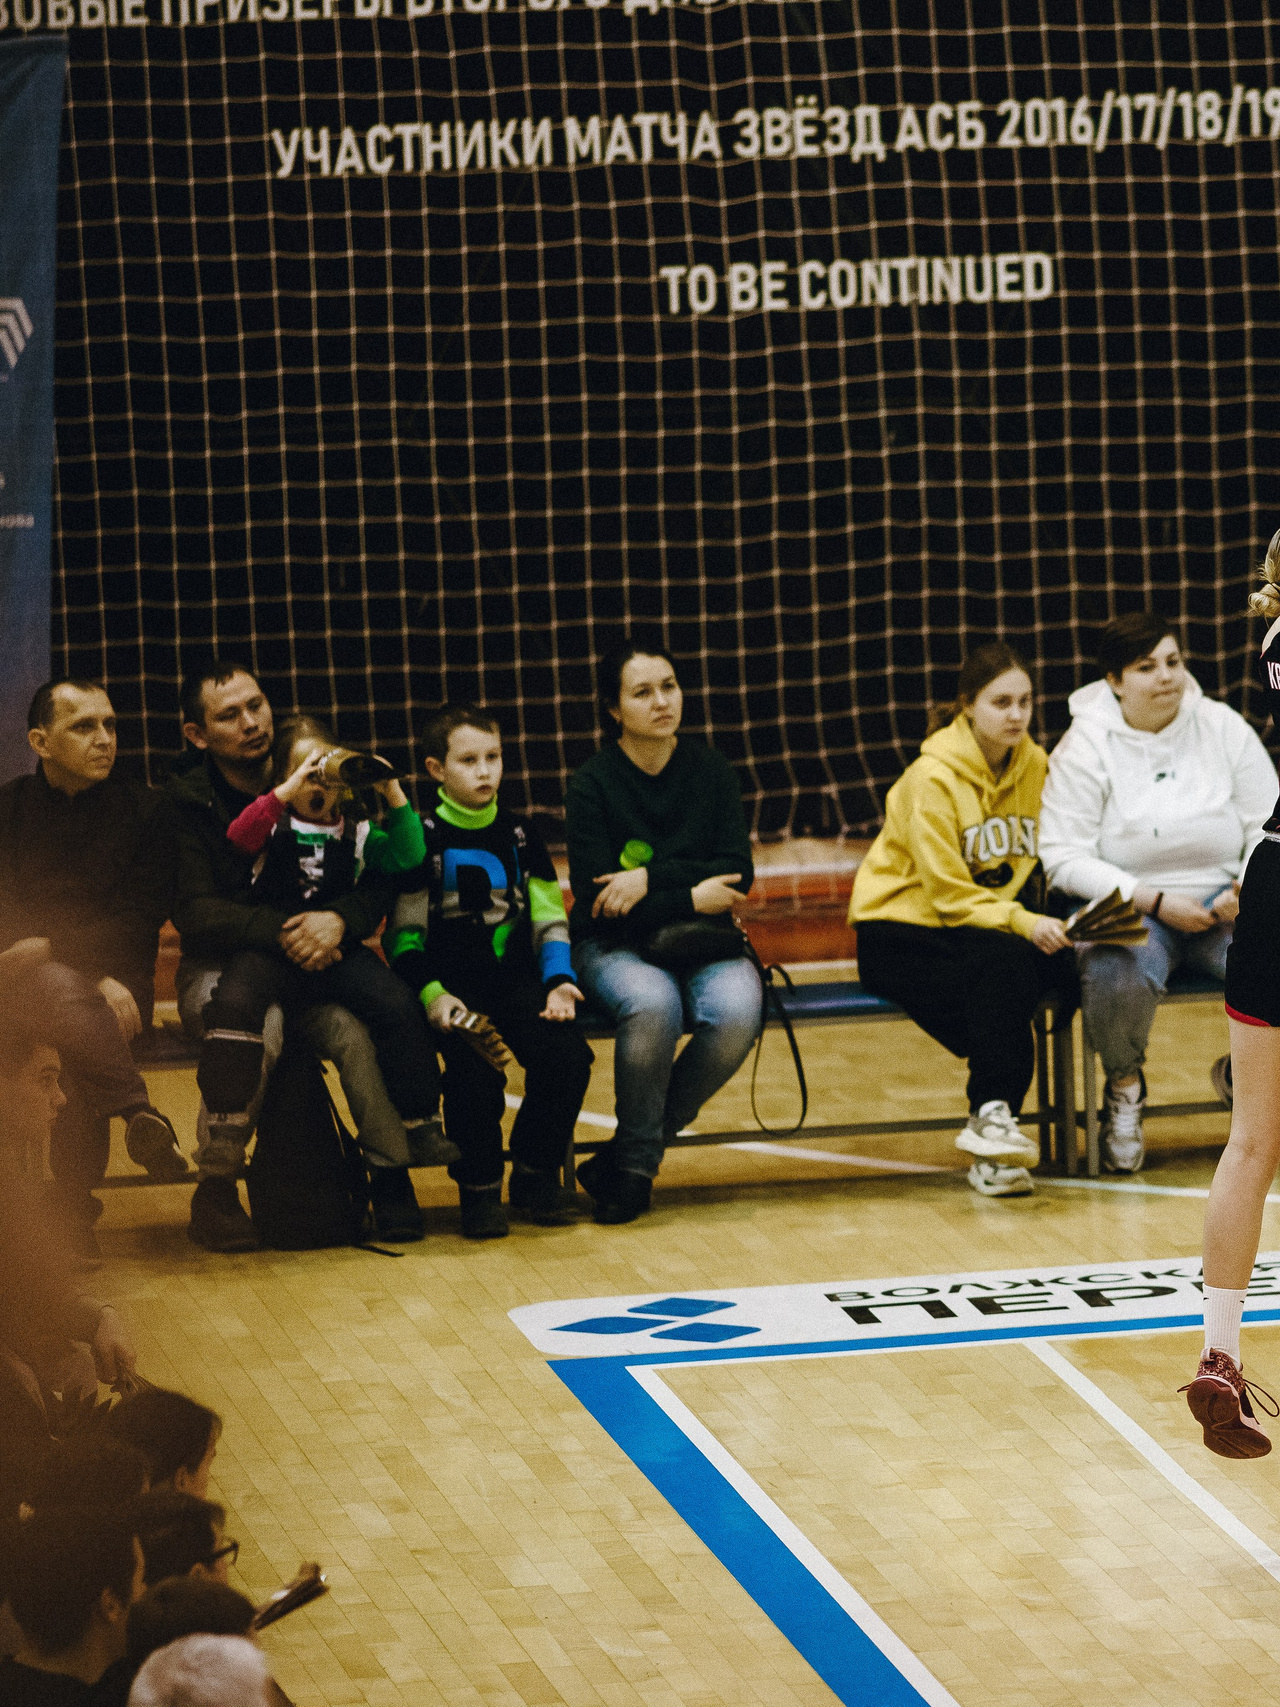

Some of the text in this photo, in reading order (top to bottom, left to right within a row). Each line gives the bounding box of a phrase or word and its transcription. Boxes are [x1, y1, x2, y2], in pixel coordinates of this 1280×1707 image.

[272, 119, 553, 178] УЧАСТНИКИ
[564, 111, 722, 165] МАТЧА
[733, 96, 887, 162] ЗВЁЗД
[895, 100, 986, 152] АСБ
[660, 252, 1054, 314] TO BE CONTINUED
